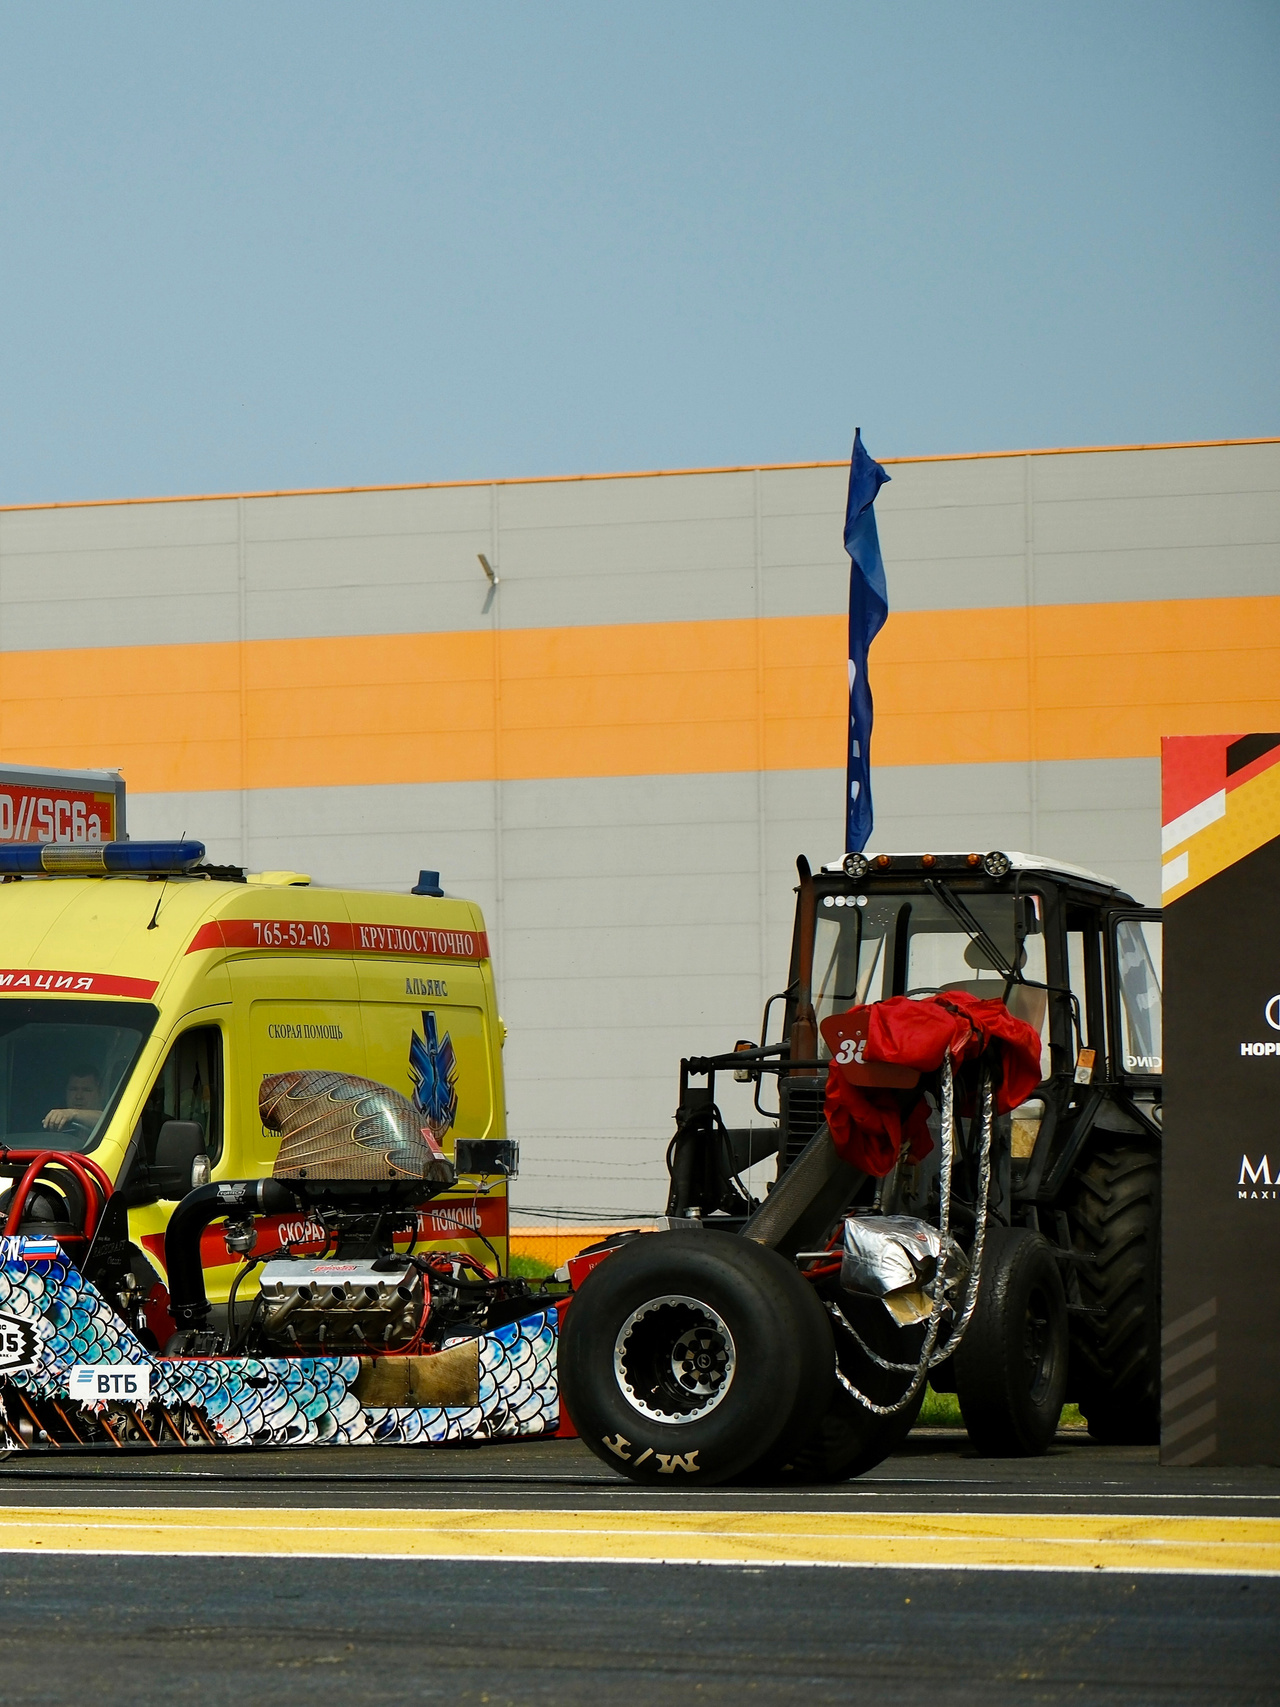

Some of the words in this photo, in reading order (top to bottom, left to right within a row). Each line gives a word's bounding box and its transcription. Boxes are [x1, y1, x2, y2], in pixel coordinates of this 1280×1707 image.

[253, 922, 331, 948] 765-52-03
[359, 926, 474, 956] КРУГЛОСУТОЧНО
[405, 977, 448, 997] АЛЬЯНС
[268, 1024, 302, 1039] СКОРАЯ
[303, 1025, 344, 1041] ПОМОЩЬ
[97, 1374, 138, 1394] ВТБ
